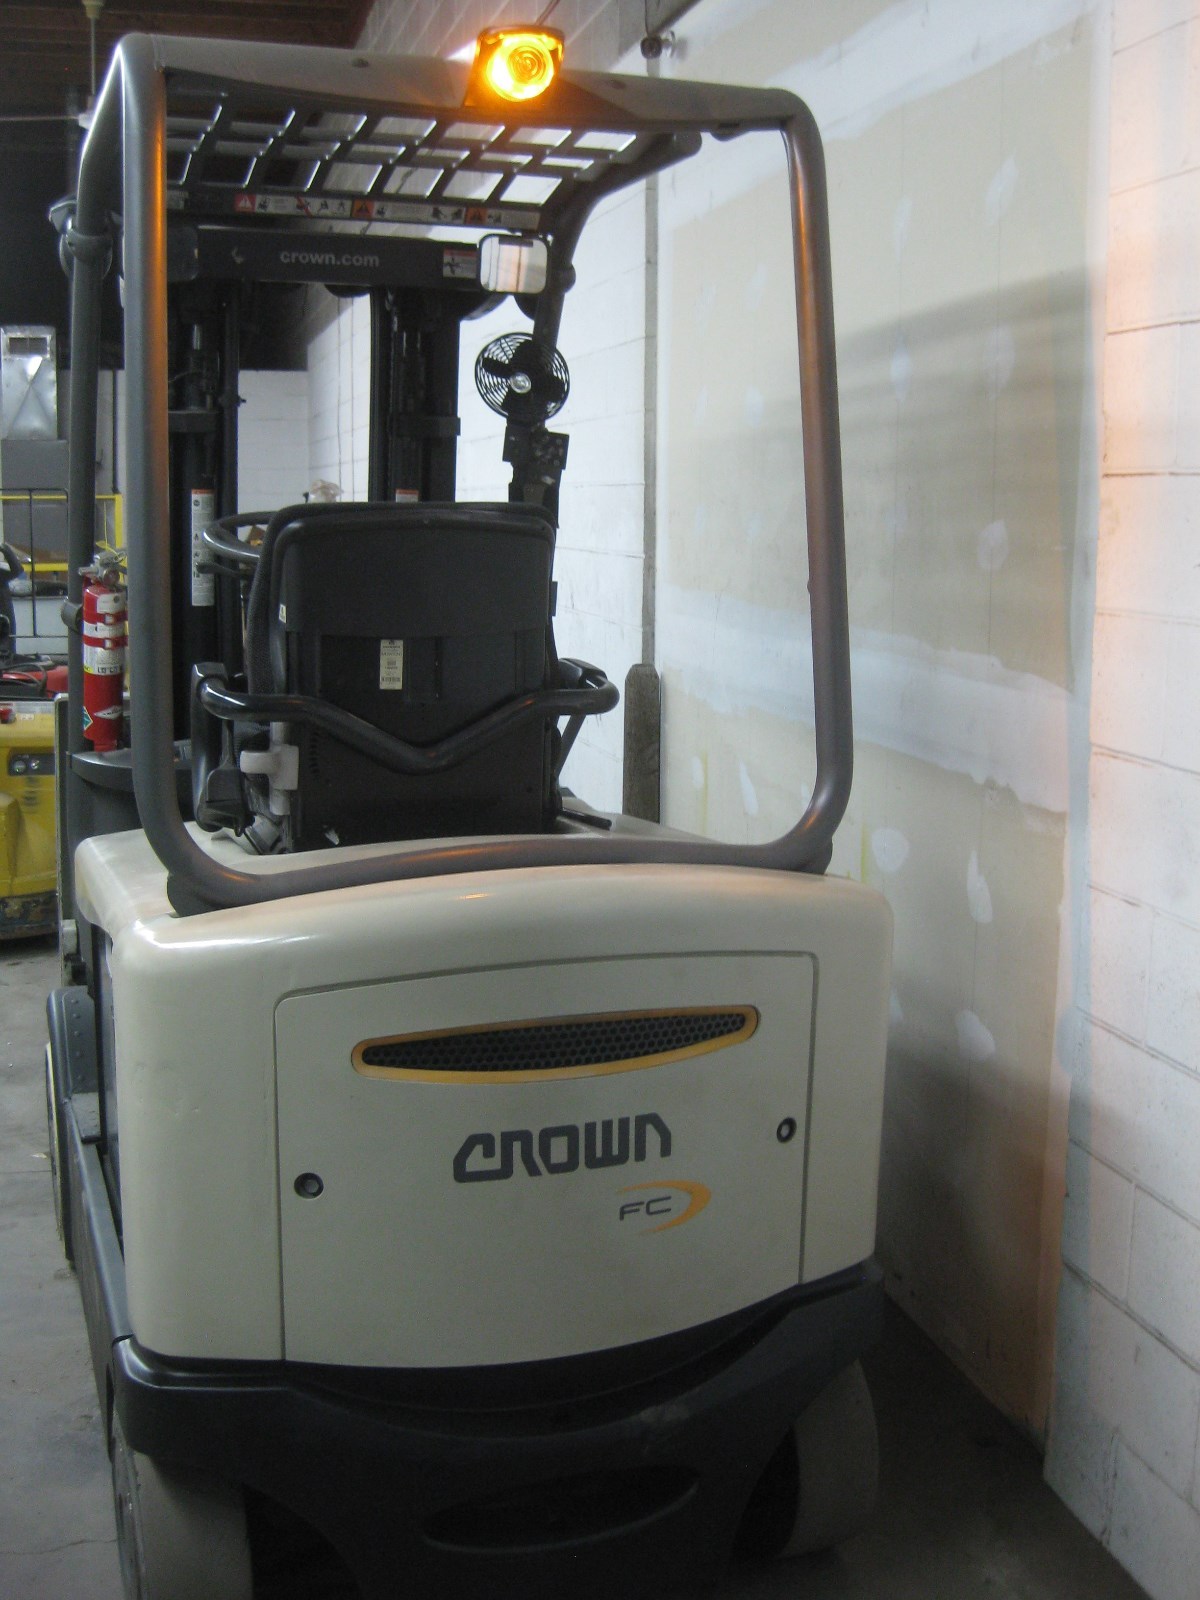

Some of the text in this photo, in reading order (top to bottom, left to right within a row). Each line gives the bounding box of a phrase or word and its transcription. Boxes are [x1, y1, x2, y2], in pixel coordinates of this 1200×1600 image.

[280, 250, 379, 267] crown.com
[453, 1112, 671, 1183] CROWN
[619, 1196, 672, 1221] FC
